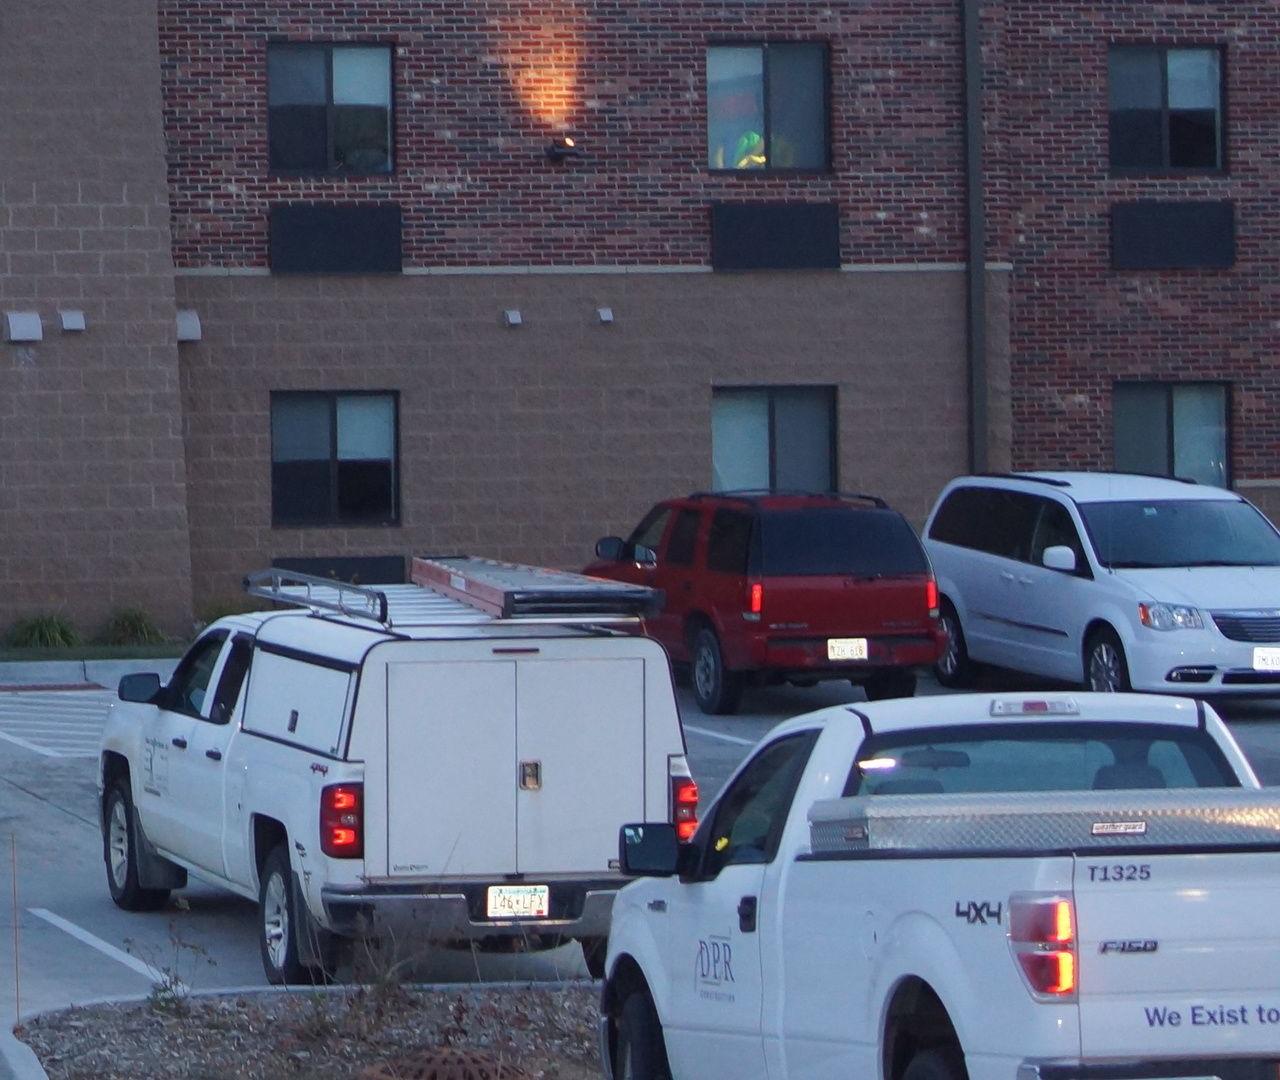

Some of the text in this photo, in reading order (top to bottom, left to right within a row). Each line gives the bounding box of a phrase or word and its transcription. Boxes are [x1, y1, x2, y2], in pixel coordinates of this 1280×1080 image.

[1087, 864, 1152, 882] T1325
[699, 940, 735, 983] DPR
[1143, 1003, 1280, 1027] We Exist to
